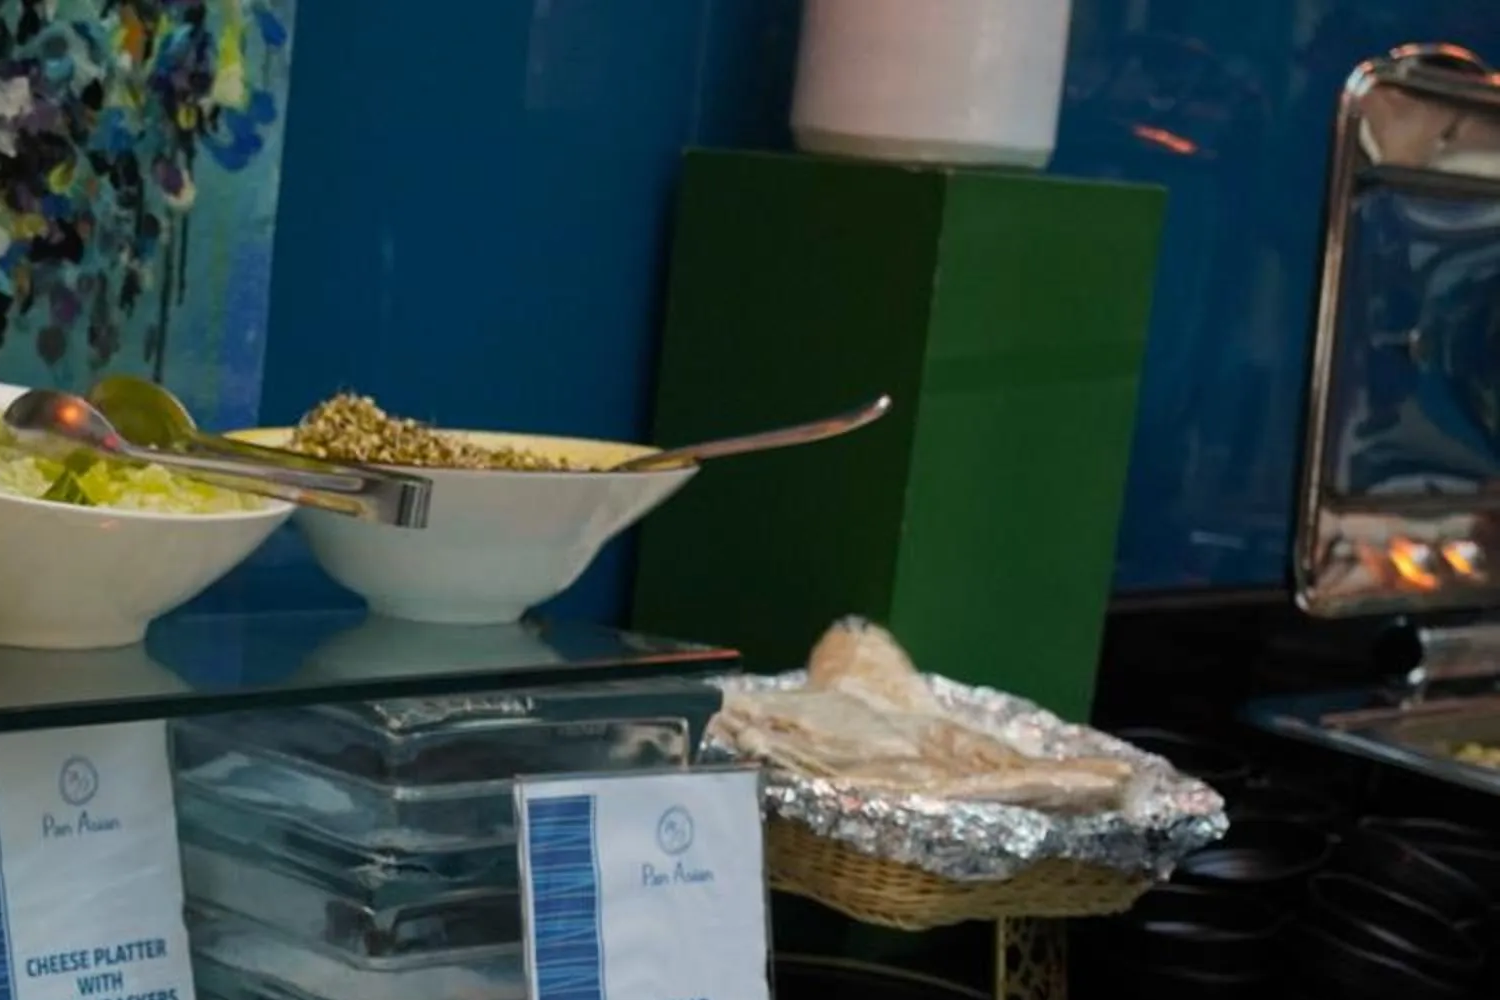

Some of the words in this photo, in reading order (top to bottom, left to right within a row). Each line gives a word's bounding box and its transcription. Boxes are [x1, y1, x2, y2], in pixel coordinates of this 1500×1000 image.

[26, 950, 92, 977] CHEESE
[93, 938, 167, 967] PLATTER
[77, 969, 124, 996] WITH
